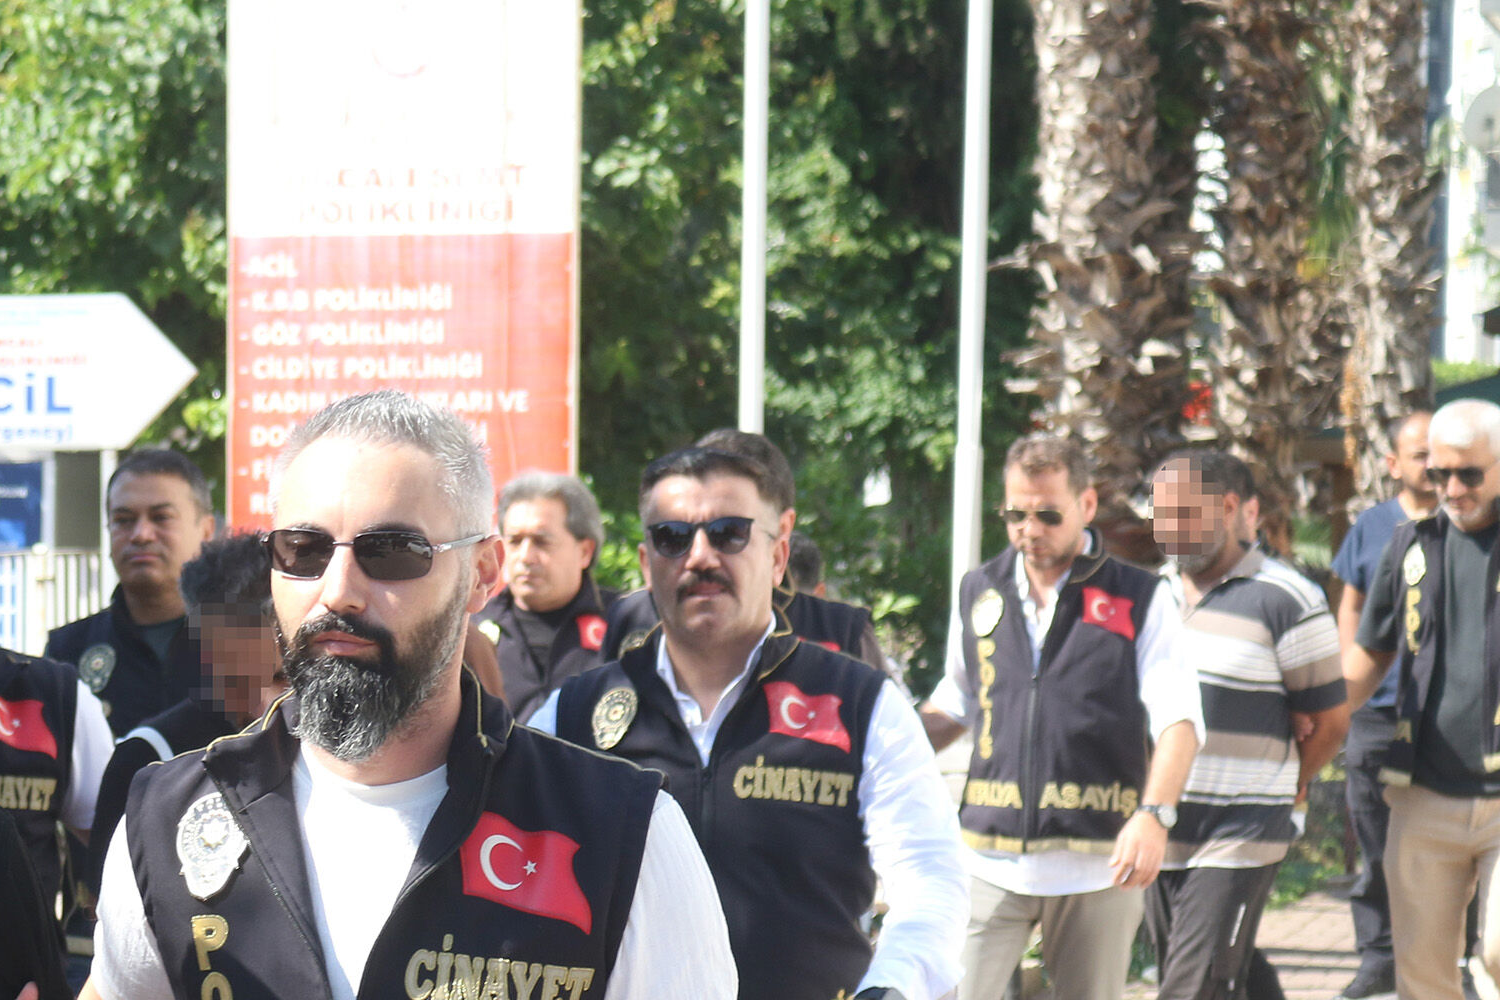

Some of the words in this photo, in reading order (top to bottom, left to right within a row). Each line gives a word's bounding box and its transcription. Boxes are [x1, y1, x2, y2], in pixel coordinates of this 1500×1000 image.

[252, 353, 338, 380] CİLDİYE
[498, 390, 531, 413] VE
[733, 755, 855, 807] CİNAYET
[1039, 780, 1138, 819] ASAYİŞ
